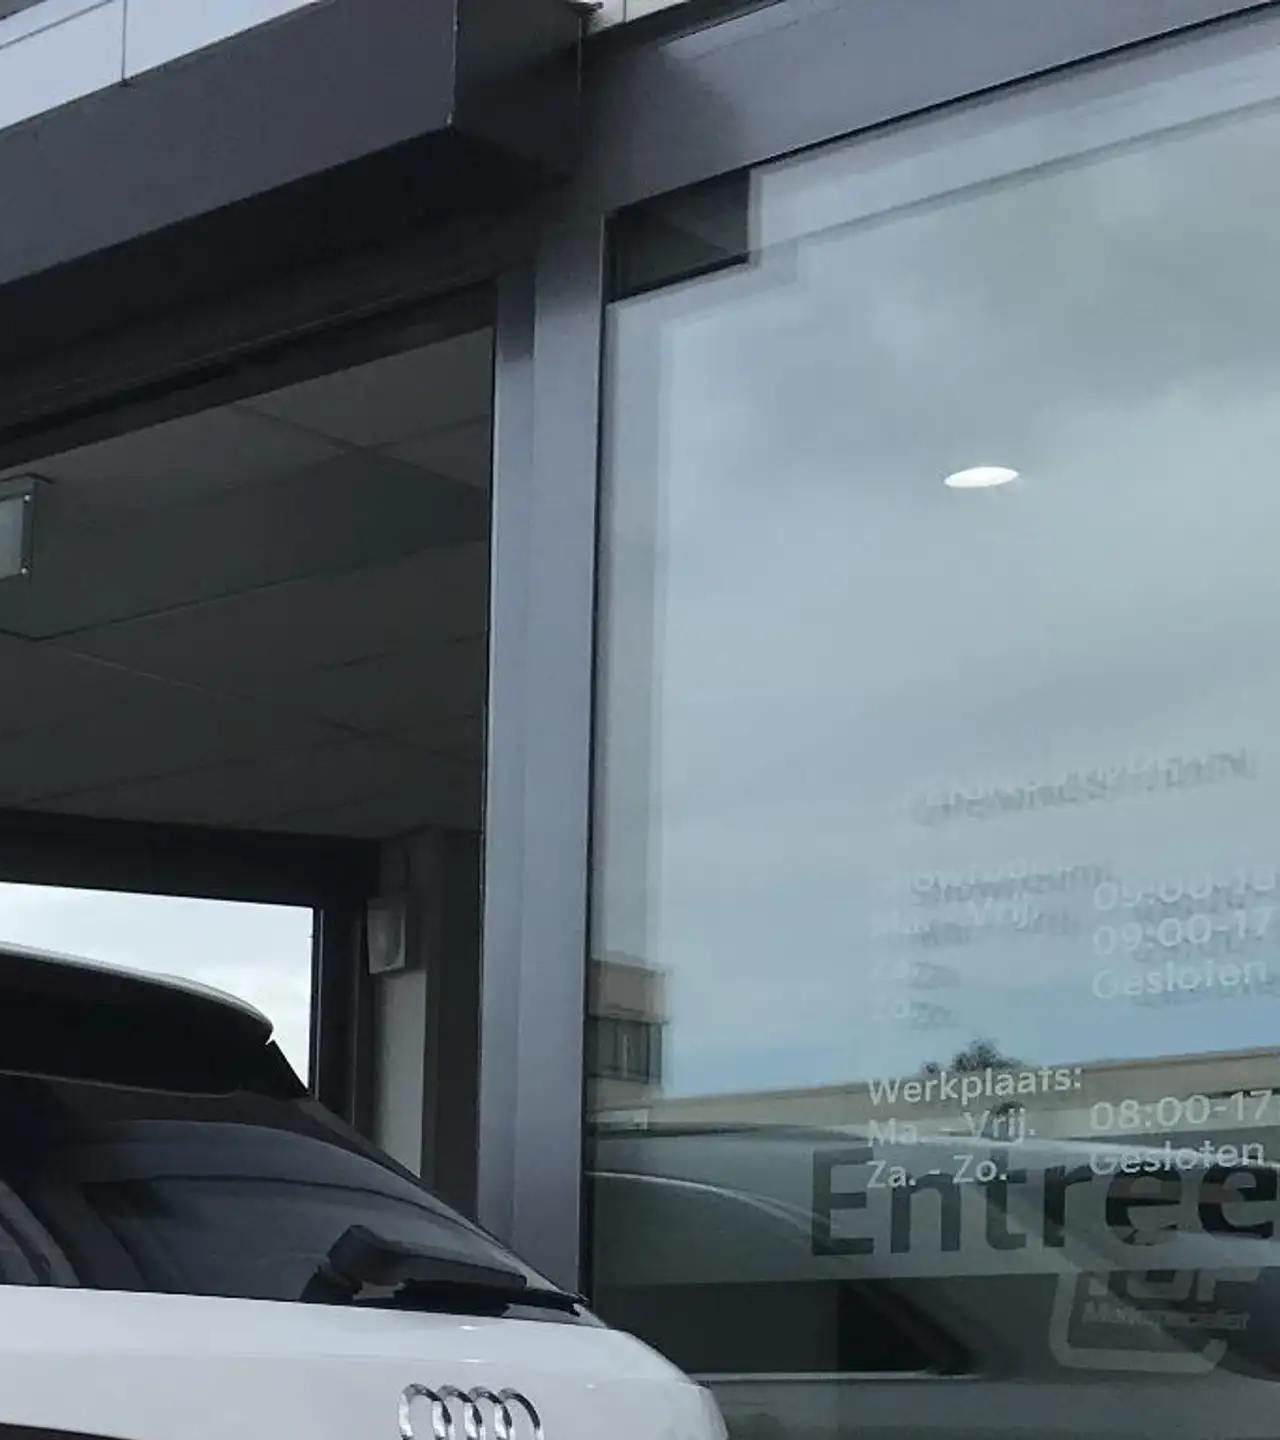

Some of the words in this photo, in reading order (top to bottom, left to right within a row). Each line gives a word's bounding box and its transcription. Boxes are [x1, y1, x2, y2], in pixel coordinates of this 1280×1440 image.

[867, 1066, 1082, 1106] Werkplaats:
[963, 1107, 1036, 1146] Vrij.
[1090, 1089, 1280, 1131] 08:00-17
[866, 1159, 916, 1189] Za.
[952, 1154, 1008, 1184] Zo.
[1090, 1139, 1265, 1175] Gesloten
[811, 1147, 1278, 1257] Entree
